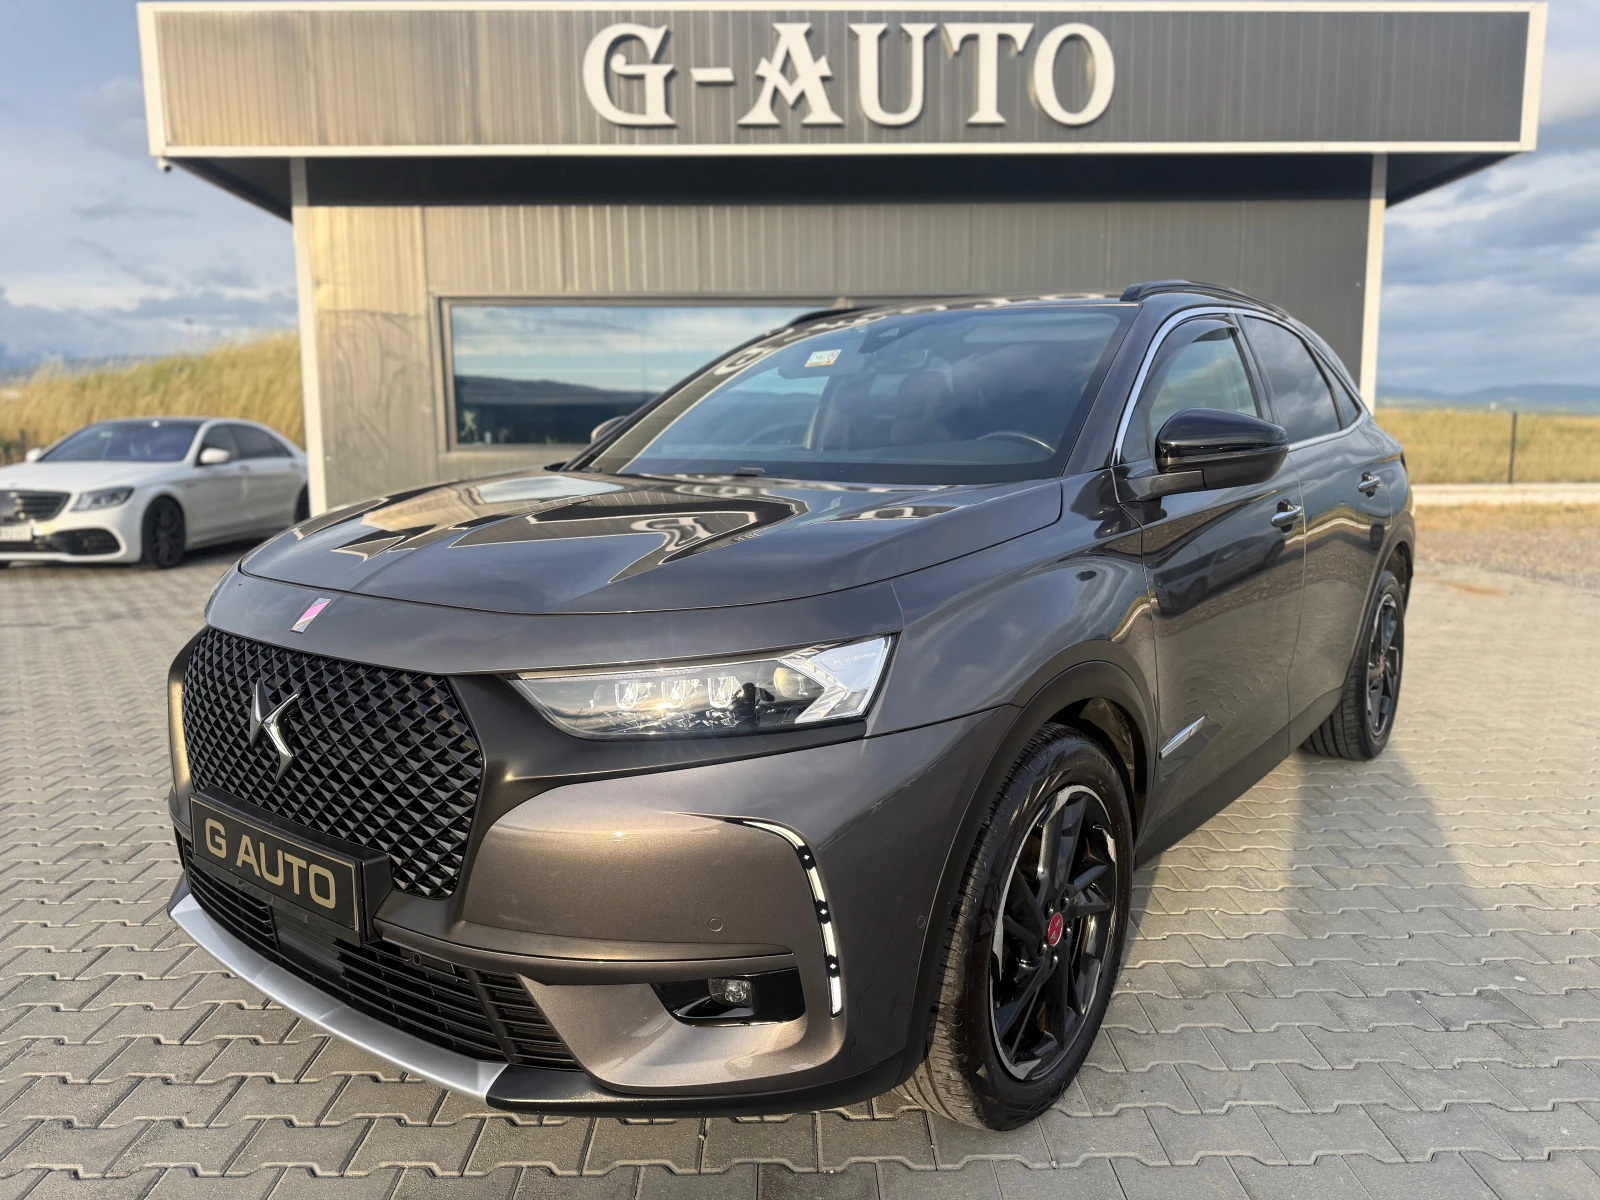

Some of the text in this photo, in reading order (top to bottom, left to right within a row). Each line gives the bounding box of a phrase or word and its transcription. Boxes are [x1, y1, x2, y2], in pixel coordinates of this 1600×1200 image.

[582, 22, 1116, 128] G-AUTO
[205, 818, 336, 909] G AUTO
